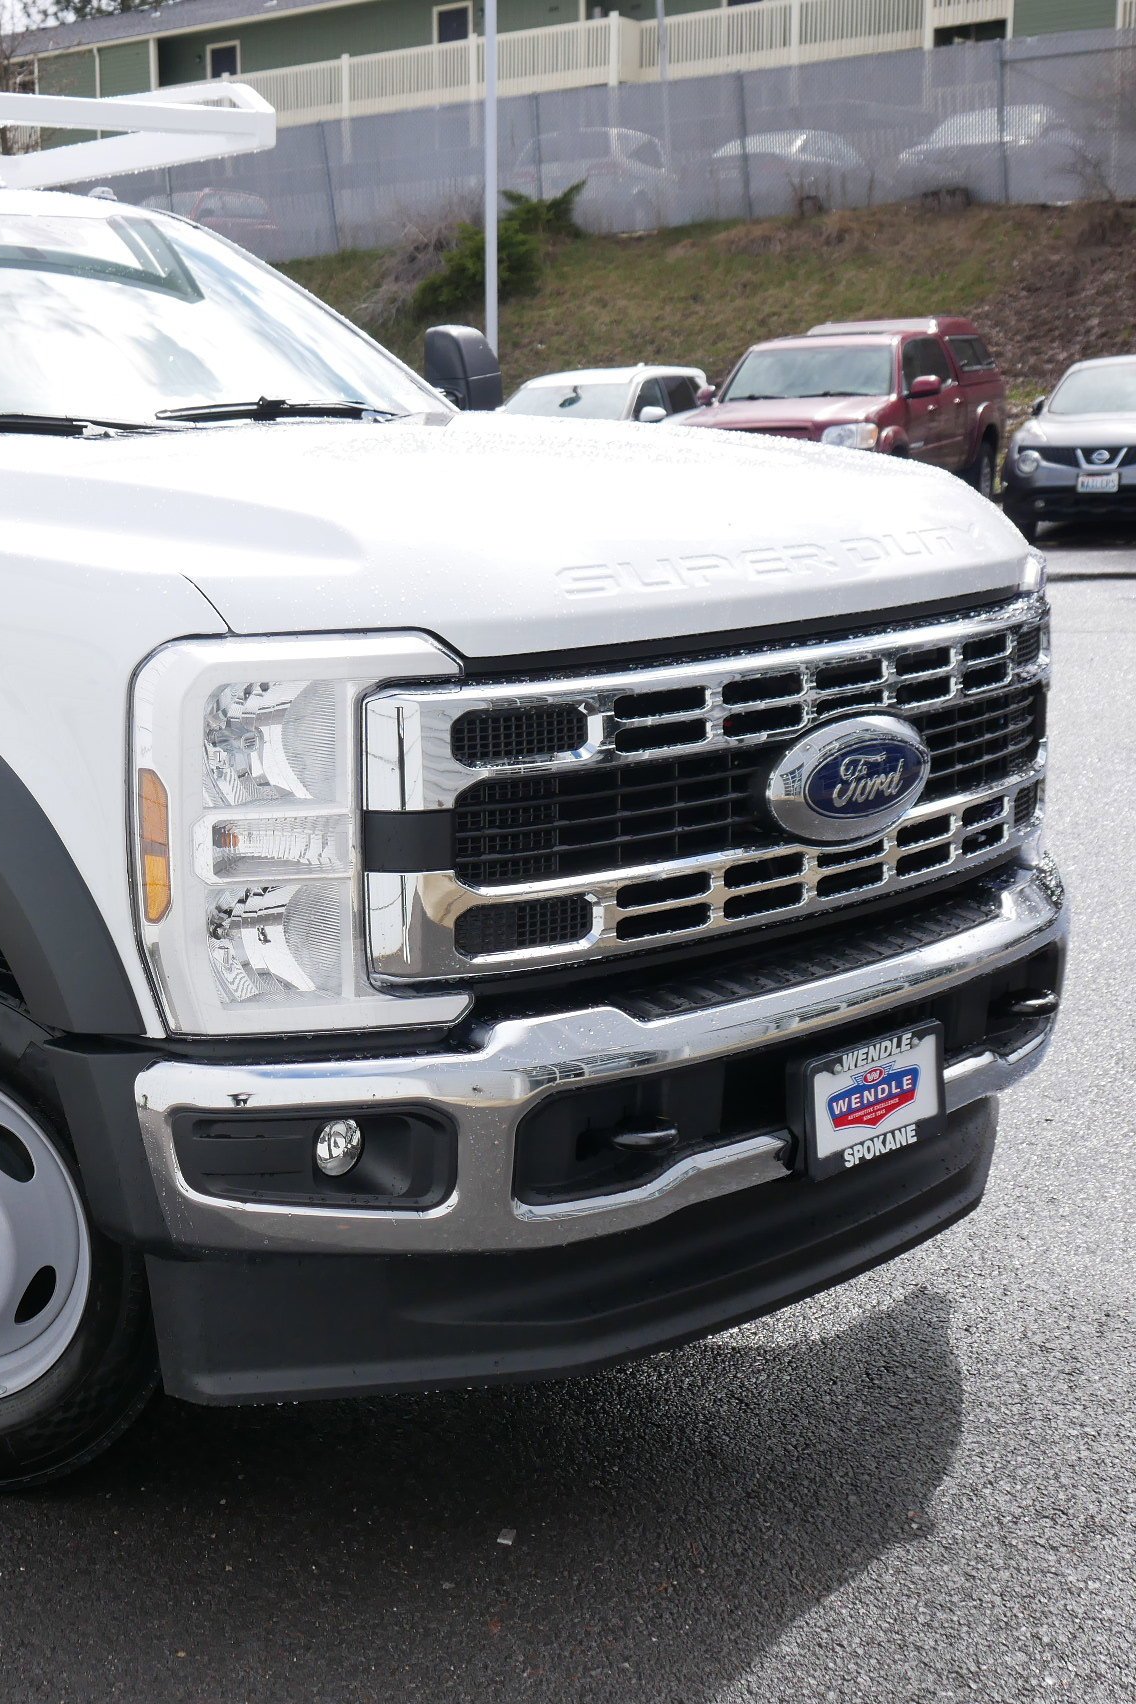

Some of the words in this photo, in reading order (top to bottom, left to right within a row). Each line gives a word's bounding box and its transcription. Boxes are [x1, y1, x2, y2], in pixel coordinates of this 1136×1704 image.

[555, 543, 839, 599] SUPER
[841, 522, 986, 567] DUTY
[833, 752, 905, 808] Ford
[842, 1033, 912, 1072] WENDLE
[832, 1075, 913, 1115] WENDLE
[848, 1106, 874, 1121] AUTOMOTIVE
[874, 1097, 900, 1111] EXCELLENCE
[863, 1112, 876, 1122] SINCE
[844, 1124, 917, 1168] SPOKANE
